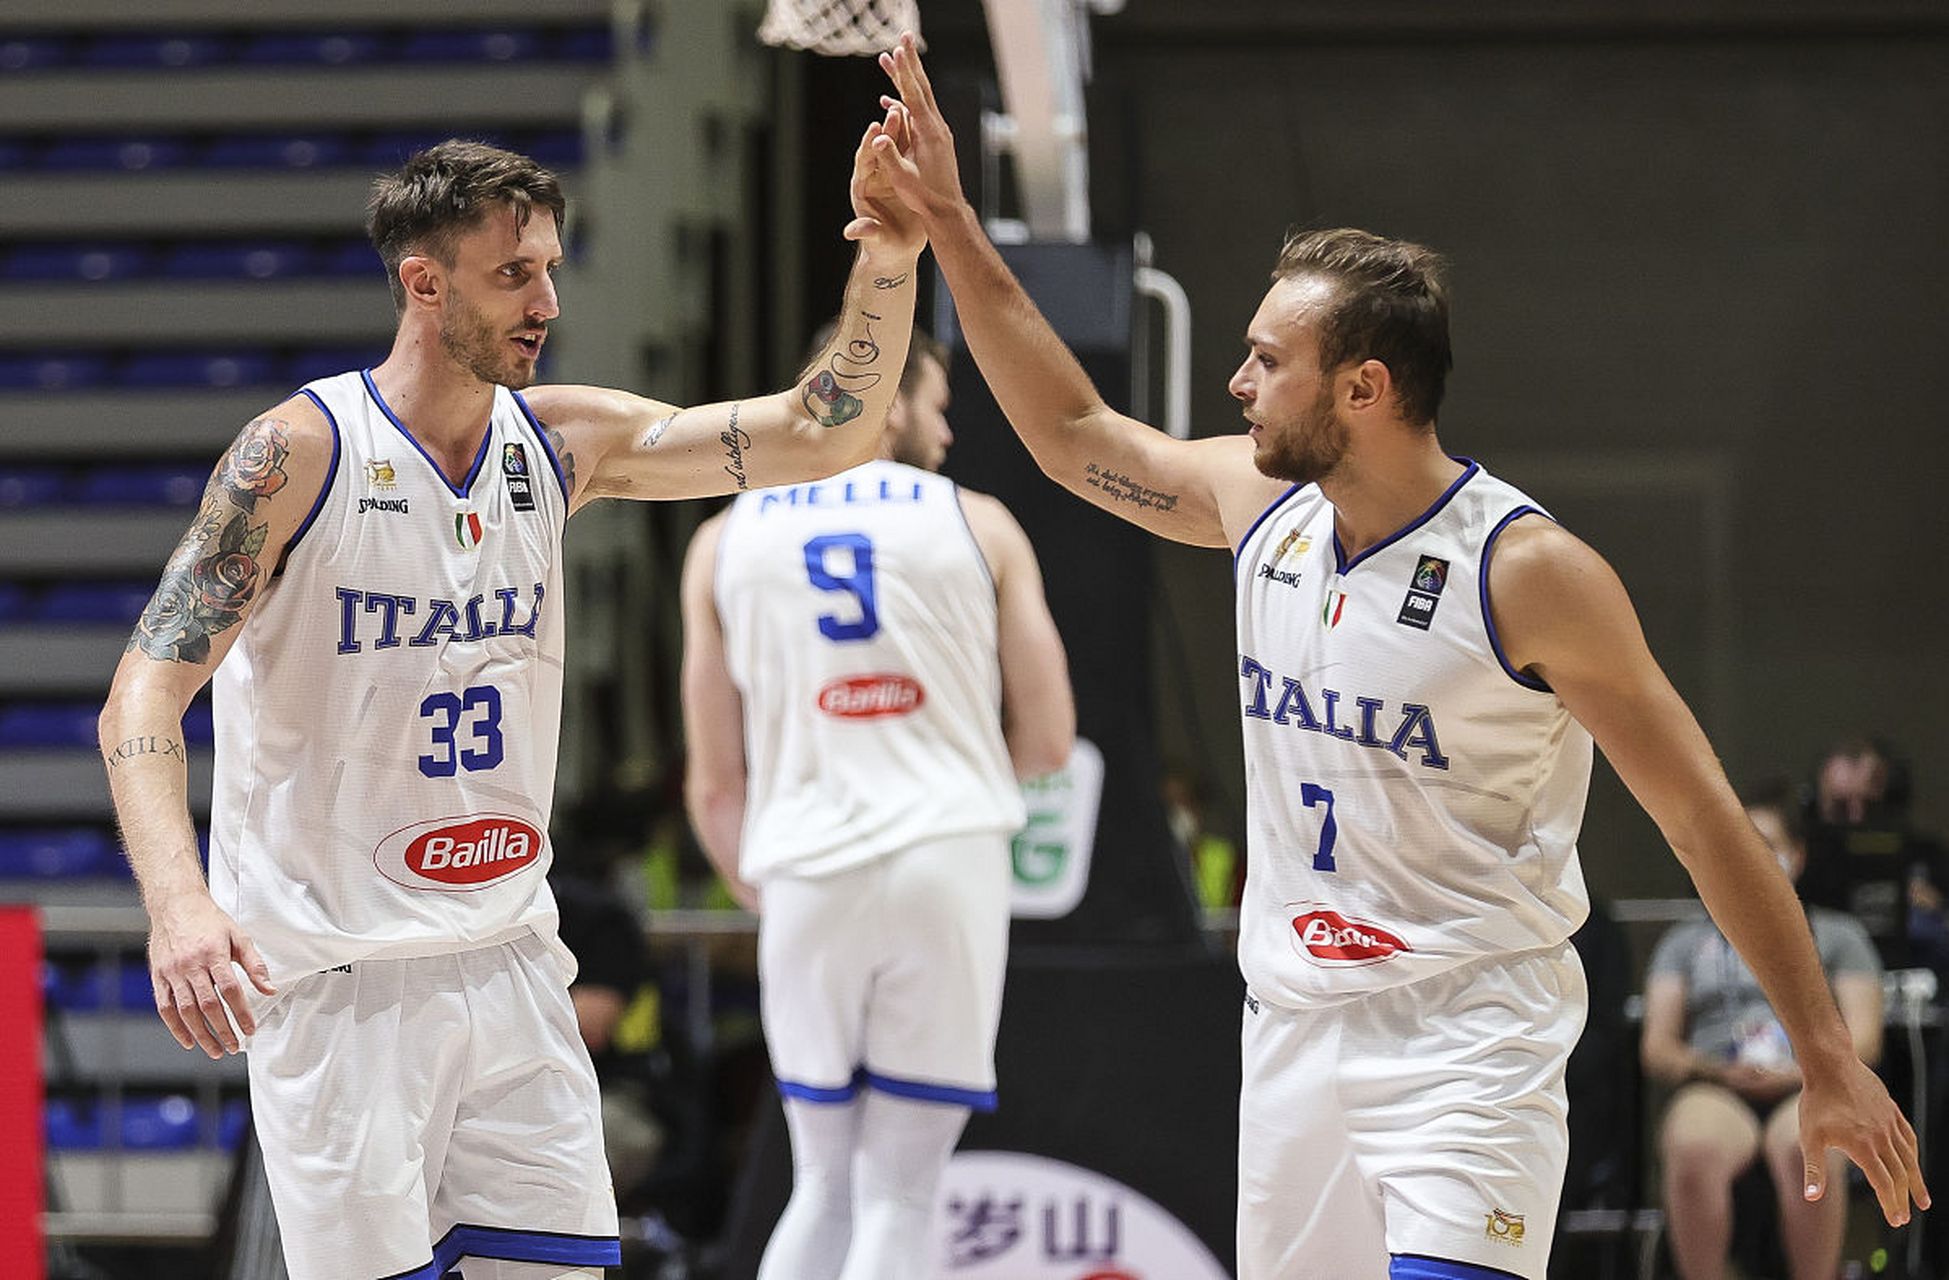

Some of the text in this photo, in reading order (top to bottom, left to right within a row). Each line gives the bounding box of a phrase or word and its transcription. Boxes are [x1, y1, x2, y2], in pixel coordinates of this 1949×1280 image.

[358, 498, 409, 514] SPALDING
[760, 480, 921, 516] MELLI
[803, 533, 878, 641] 9
[1257, 563, 1302, 588] SPALDING
[1408, 595, 1433, 612] FIBA
[418, 685, 504, 779] 33
[1241, 655, 1450, 771] TALIA
[420, 826, 530, 871] Barilla
[1300, 782, 1338, 872] 7
